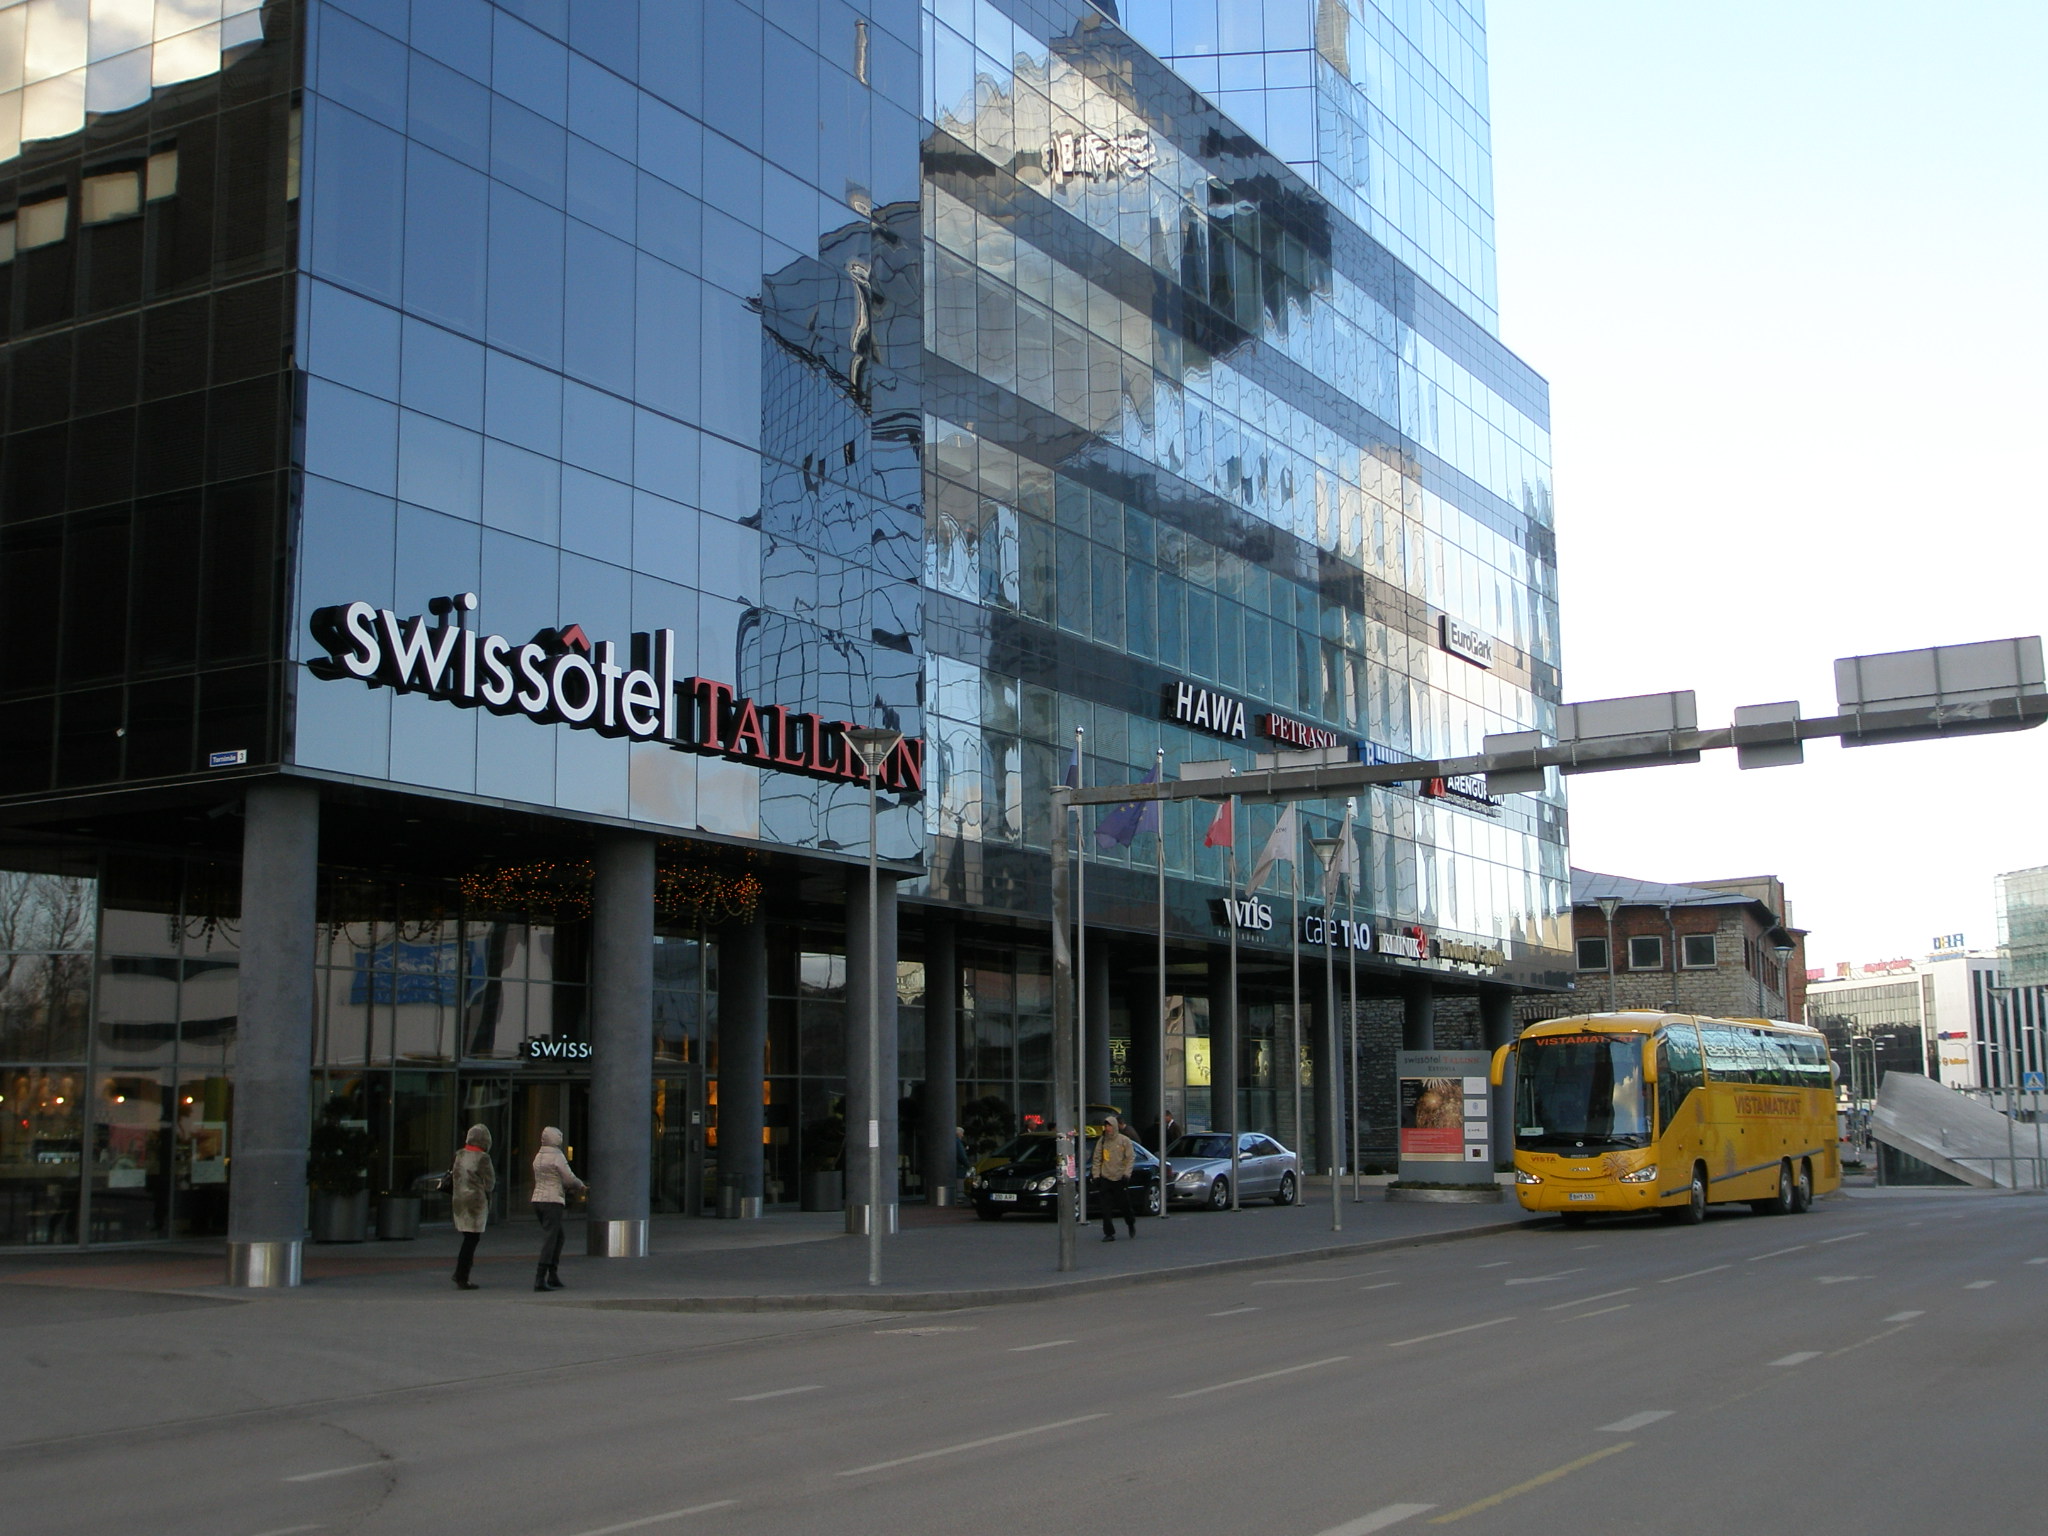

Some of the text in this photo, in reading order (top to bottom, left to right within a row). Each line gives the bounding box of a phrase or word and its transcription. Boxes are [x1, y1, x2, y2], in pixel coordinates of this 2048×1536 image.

[1176, 681, 1246, 740] HAWA
[1340, 919, 1371, 951] TAO
[530, 1034, 593, 1058] swiss
[1734, 1095, 1801, 1116] VISTAMATKAT
